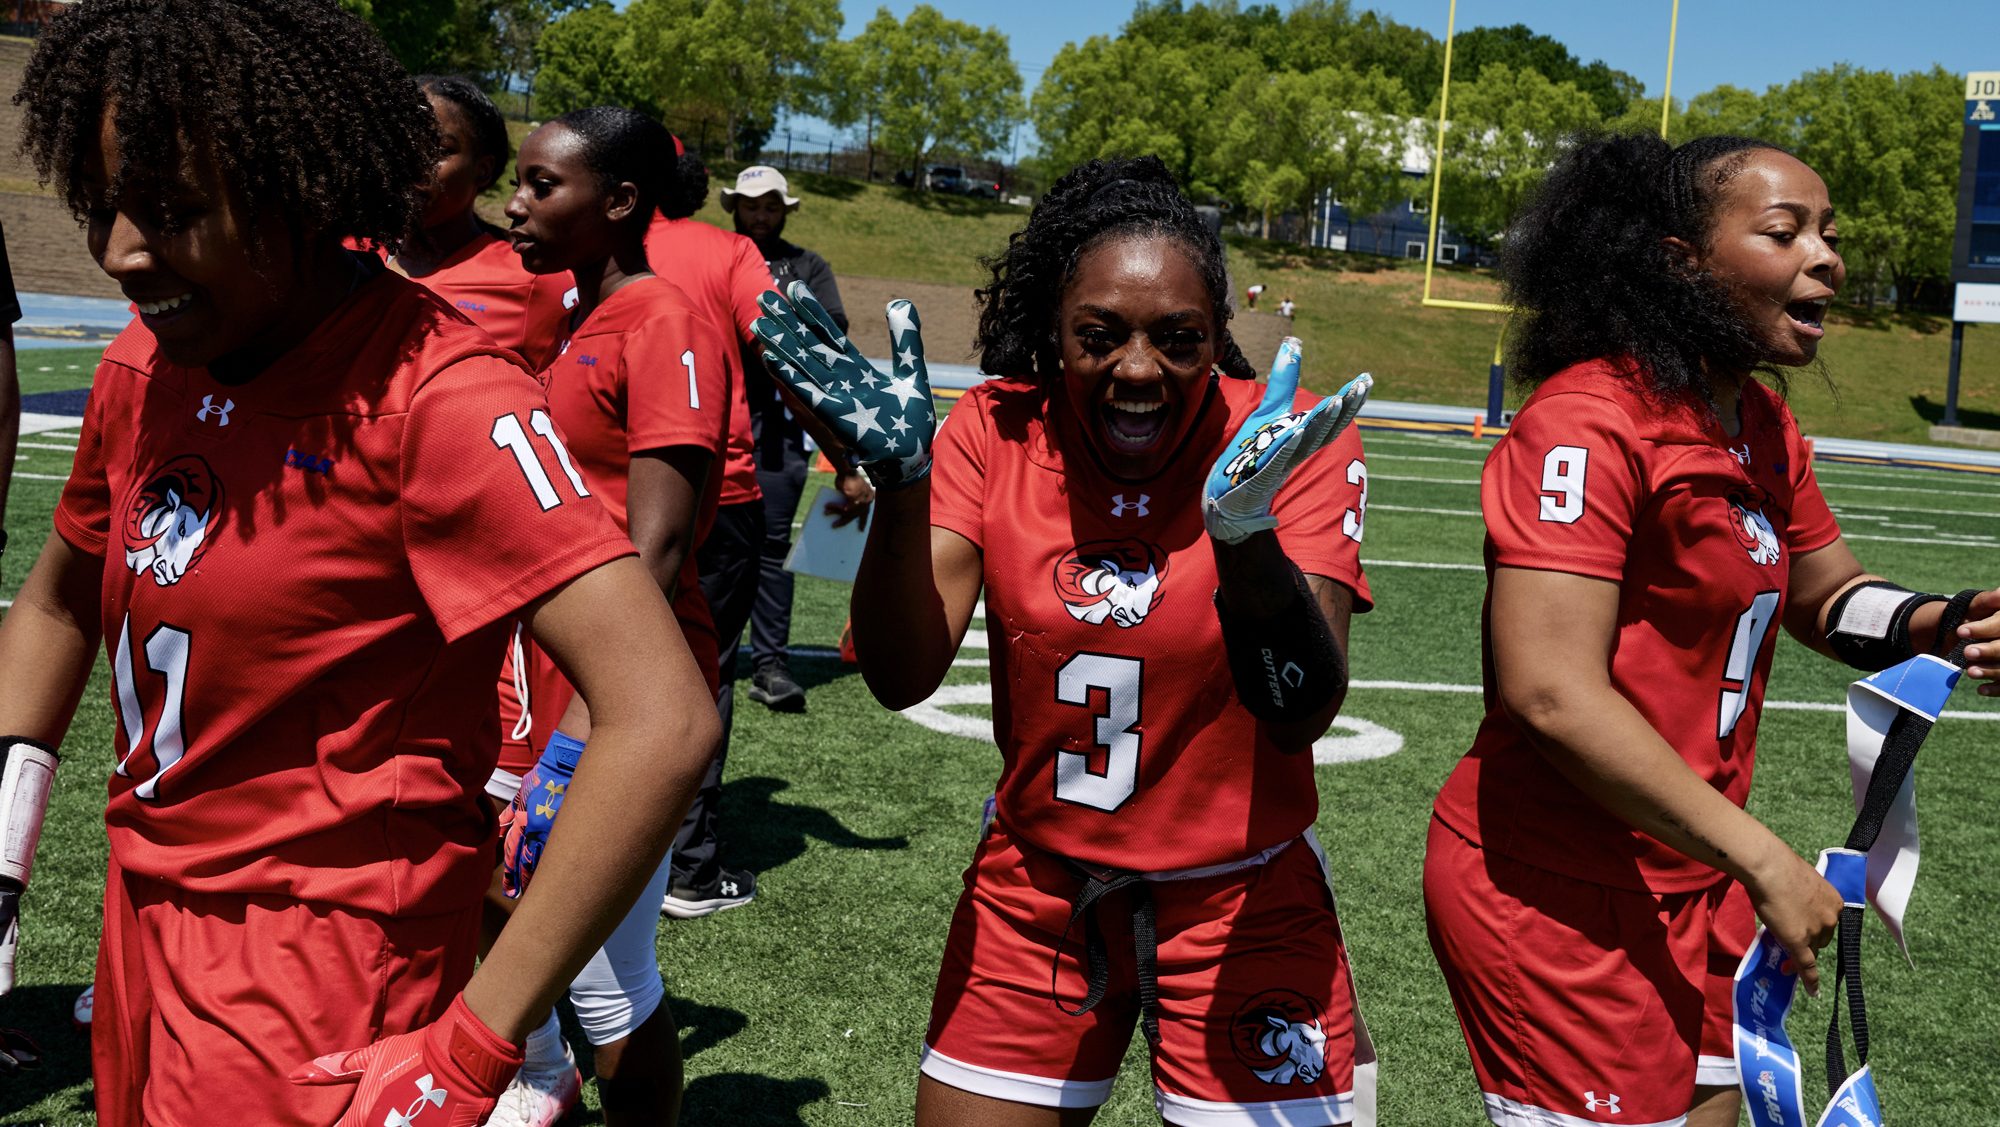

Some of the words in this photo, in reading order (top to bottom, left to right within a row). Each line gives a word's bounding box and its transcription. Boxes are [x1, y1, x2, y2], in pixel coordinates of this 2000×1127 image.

[1973, 81, 2000, 95] JO
[680, 349, 701, 410] 1
[490, 409, 592, 513] 11
[1341, 457, 1368, 544] 3
[1538, 444, 1589, 524] 9
[114, 608, 193, 802] 11
[1261, 648, 1284, 708] CUTTERS
[1716, 589, 1780, 740] 9
[1053, 650, 1145, 815] 3
